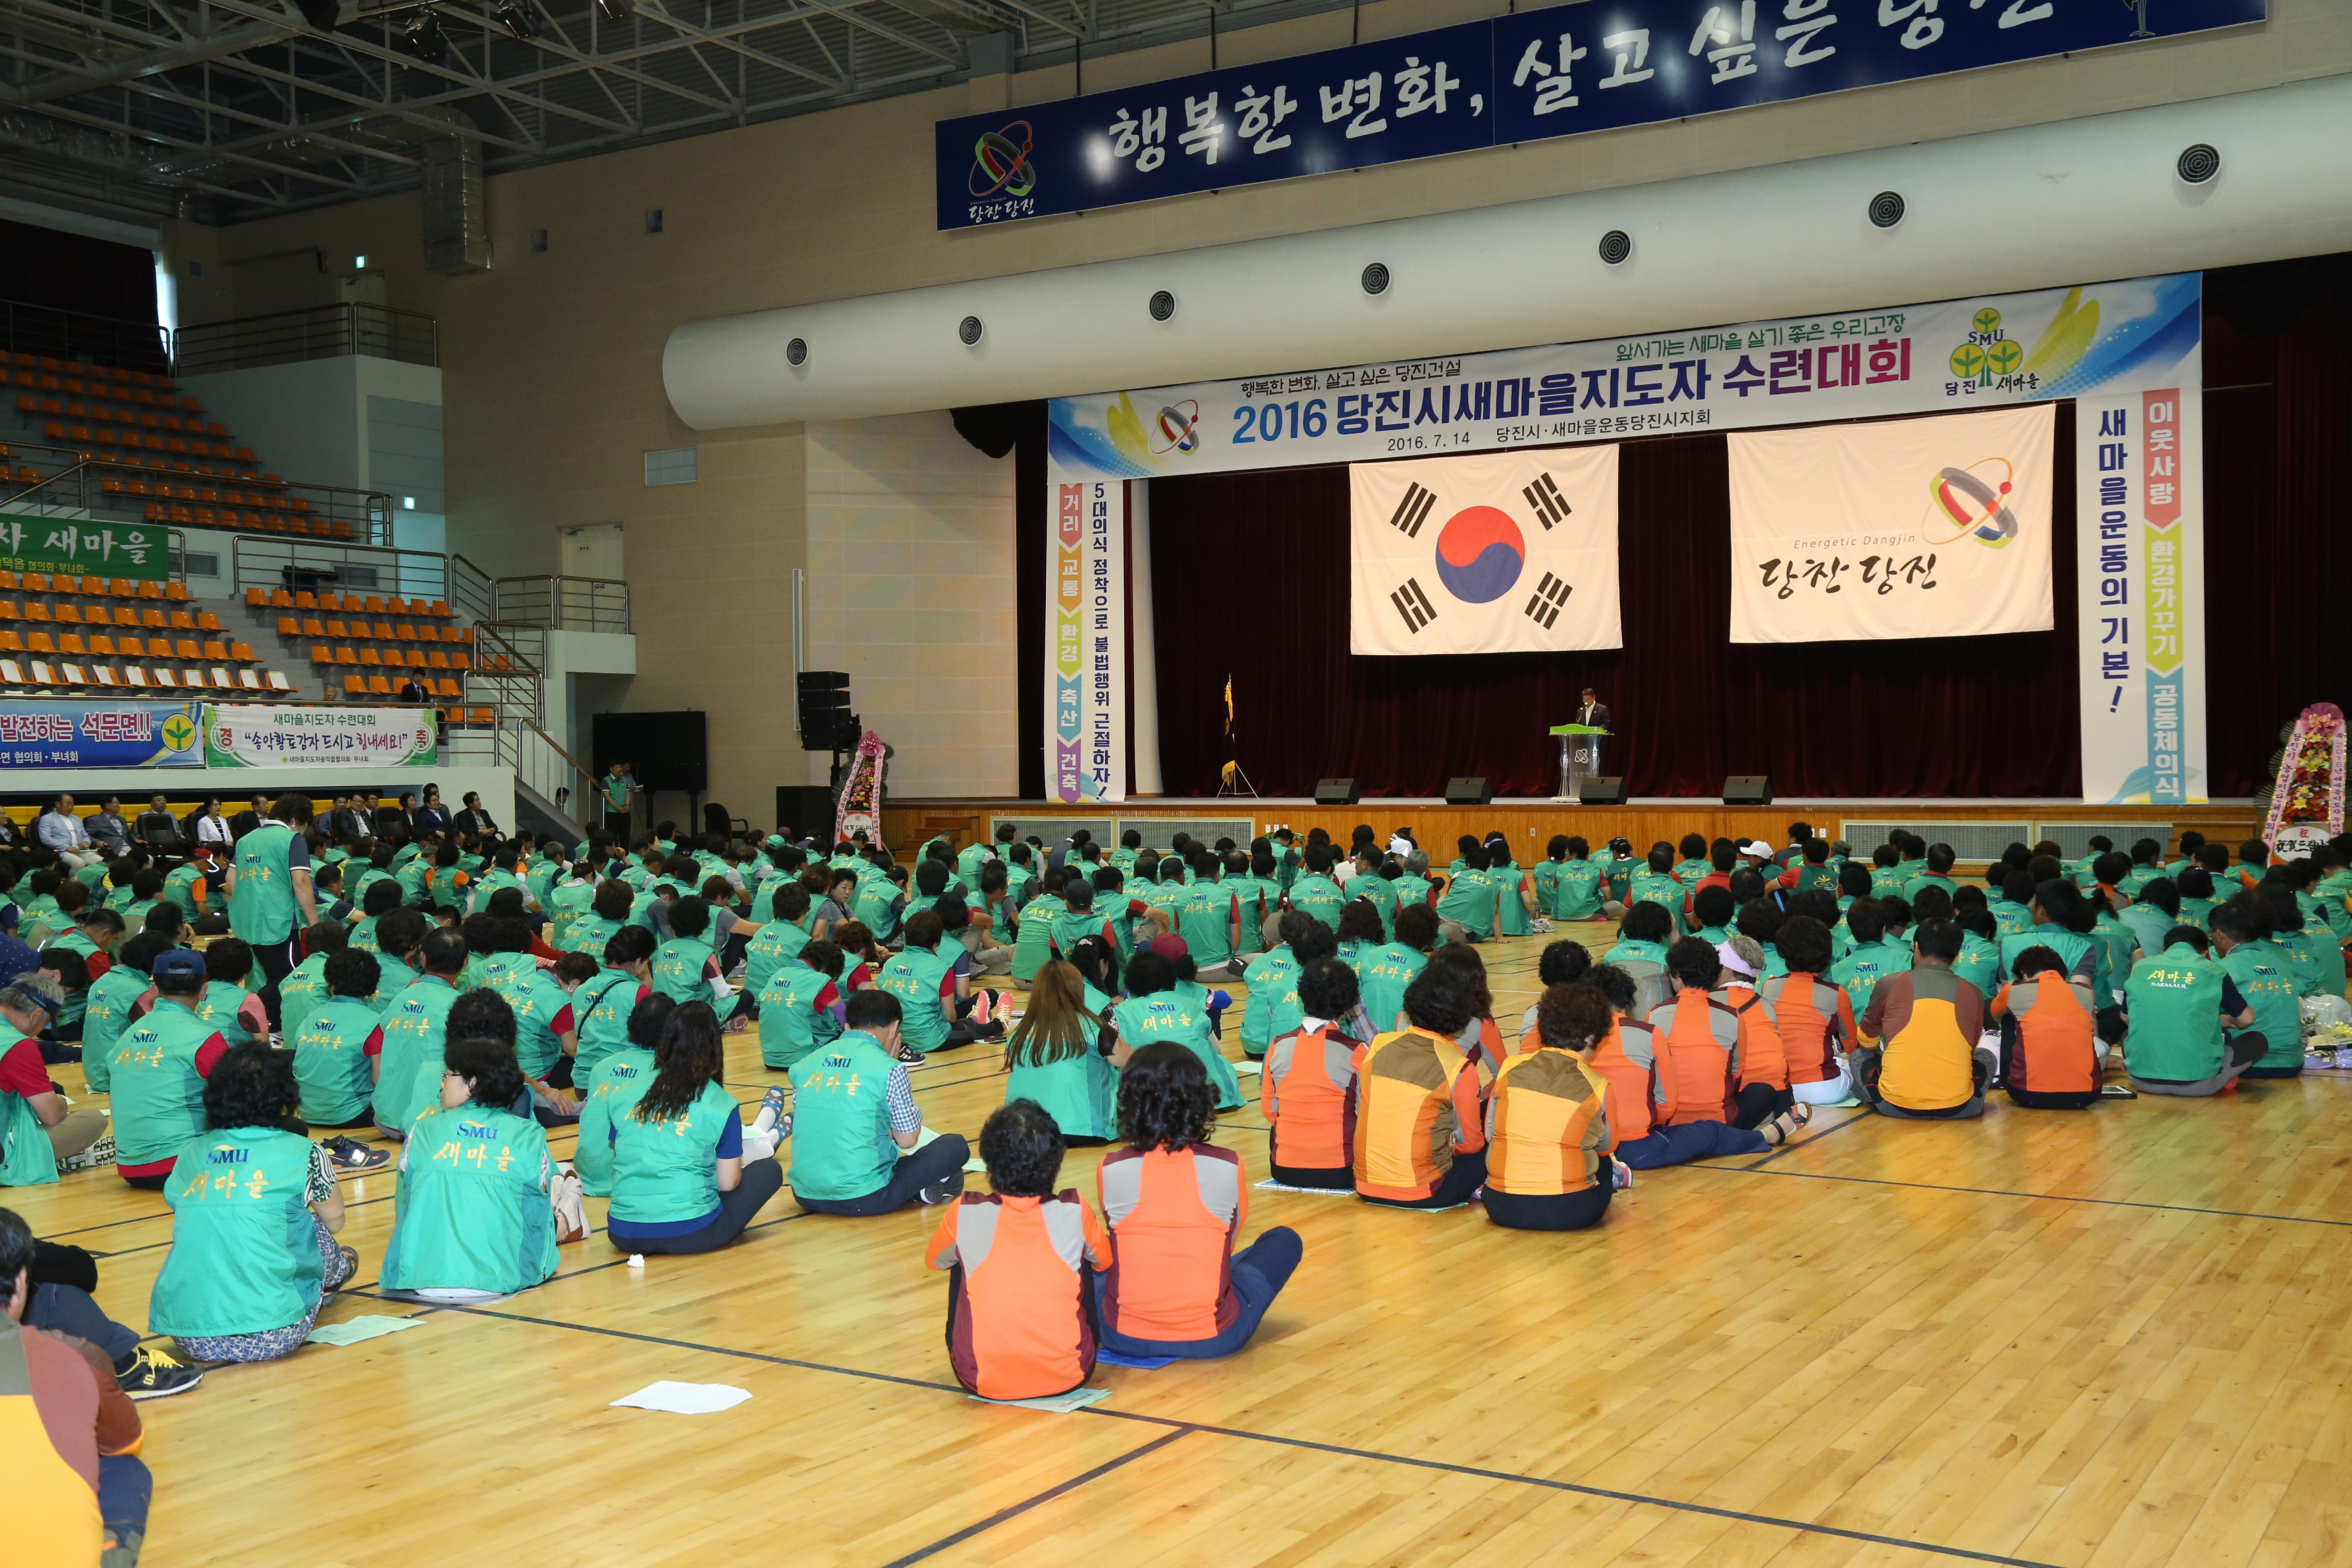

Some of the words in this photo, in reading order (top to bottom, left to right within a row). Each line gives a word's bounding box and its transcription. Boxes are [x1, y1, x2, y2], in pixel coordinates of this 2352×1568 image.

[1109, 84, 1298, 172] 행복한
[1321, 57, 1483, 138] 변화,
[1514, 33, 1654, 116] 살고
[1688, 0, 1838, 82] 싶은
[1004, 198, 1034, 217] 당진
[1617, 338, 1684, 362] 앞서가는
[1690, 335, 1742, 354] 새마을
[1748, 327, 1783, 347] 살기
[1788, 322, 1825, 343] 좋은
[1830, 314, 1906, 336] 우리고장
[1969, 329, 2004, 346] SMU
[1241, 381, 1284, 398] 행복한
[1288, 377, 1321, 394] 변화,
[1326, 371, 1355, 388] 살고
[1360, 368, 1391, 386] 싶은
[1395, 359, 1461, 382] 당진건설
[1945, 380, 1976, 396] 당진
[1995, 372, 2040, 393] 새마을
[1232, 398, 1328, 444] 2016
[1336, 359, 1711, 435] 당진시새마을지도자
[1723, 338, 1911, 397] 수련대회
[1387, 436, 1428, 451] 2016.
[1434, 434, 1446, 447] 7.
[1454, 431, 1470, 445] 14
[2149, 402, 2175, 505] 이웃사랑
[1063, 495, 1079, 532] 거리
[2098, 409, 2129, 606] 새마을운동의
[1092, 483, 1107, 553] 5대의식
[44, 525, 153, 564] 새마을
[1793, 537, 1857, 550] Energetic
[1863, 534, 1916, 548] Dangjin
[0, 557, 24, 570] 덕읍
[1062, 559, 1078, 597] 교통
[1759, 556, 1850, 600] 당찬
[1859, 553, 1937, 595] 당진
[1093, 559, 1109, 631] 정착으로
[2151, 540, 2177, 656] 환경가꾸기
[1061, 623, 1078, 662] 환경
[1094, 637, 1110, 706] 불법행위
[2101, 617, 2130, 713] 기본!
[1061, 688, 1078, 727] 축산
[0, 714, 74, 742] 발전하는
[80, 712, 152, 742] 석문면!!
[274, 713, 334, 726] 새마을지도자
[337, 714, 376, 726] 수련대회
[220, 728, 232, 746] 경
[322, 732, 354, 751] 드시고
[416, 729, 427, 746] 축
[2153, 684, 2180, 797] 공동체의식
[0, 751, 10, 764] 면
[1093, 713, 1111, 800] 근절하자!
[1061, 753, 1077, 791] 건축
[2332, 816, 2342, 836] 수련대
[245, 855, 261, 863] SMU
[240, 867, 271, 881] 새마을
[1469, 874, 1491, 885] 새마을
[1566, 872, 1589, 881] 새마을
[1683, 870, 1707, 878] 새마을
[1153, 895, 1176, 903] 새마을
[1643, 892, 1672, 901] 새마을
[1029, 907, 1054, 919] 새마을
[1185, 902, 1215, 912] 새마을
[555, 911, 580, 921] 새마을
[2176, 917, 2200, 926] 새마을
[579, 941, 606, 955] 새마을
[751, 941, 782, 956] 새마을
[655, 961, 683, 974] 새마을
[1386, 955, 1407, 964] SMU
[1856, 964, 1878, 972] SMU
[292, 972, 309, 980] SMU
[487, 964, 506, 974] SMU
[1256, 971, 1283, 984] 새마
[1371, 964, 1413, 982] 새마을
[2147, 970, 2196, 985] 새마을
[481, 970, 517, 987] 새마을
[882, 977, 919, 994] 새마을
[1848, 976, 1876, 991] 새마
[2248, 979, 2292, 995] 새마을
[514, 984, 533, 995] SMU
[761, 992, 796, 1007] 새마을
[402, 1003, 425, 1014] SMU
[1149, 1004, 1176, 1013] SMU
[314, 1022, 336, 1031] SMU
[387, 1016, 430, 1036] 새마을
[1141, 1013, 1191, 1031] 새마을
[132, 1033, 157, 1043] SMU
[308, 1034, 342, 1049] 새마을
[115, 1046, 164, 1067] 새마을
[822, 1057, 852, 1068] SMU
[610, 1067, 638, 1078] SMU
[804, 1072, 862, 1095] 새마을
[457, 1123, 498, 1139] SMU
[206, 1149, 249, 1164] SMU
[433, 1142, 514, 1171] 새마을
[183, 1169, 269, 1200] 새마을
